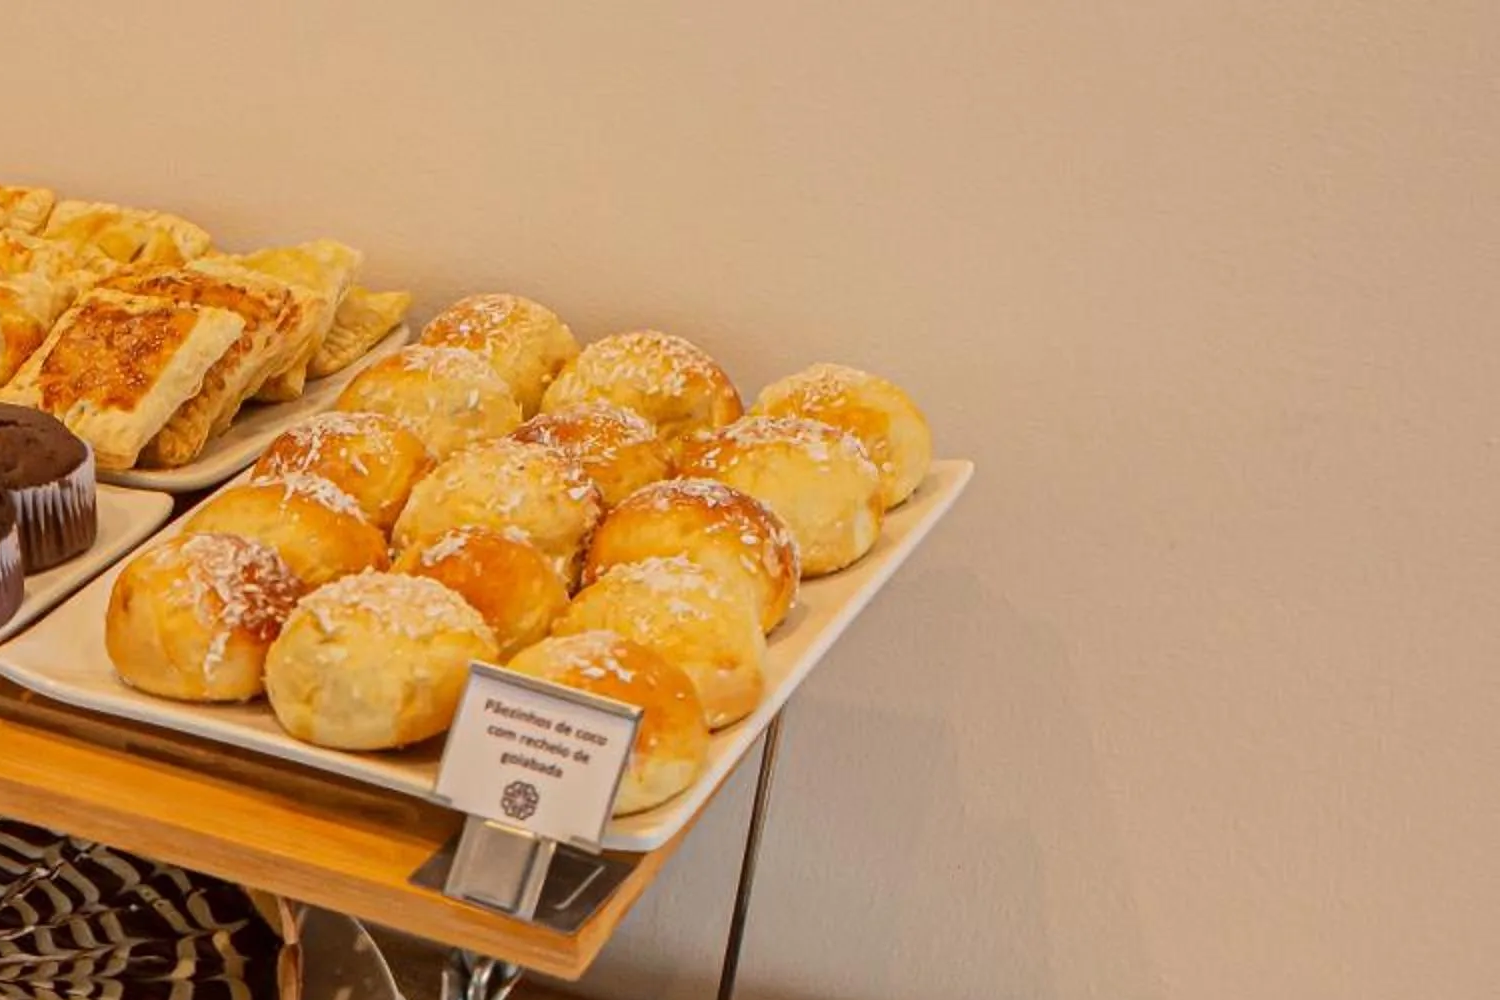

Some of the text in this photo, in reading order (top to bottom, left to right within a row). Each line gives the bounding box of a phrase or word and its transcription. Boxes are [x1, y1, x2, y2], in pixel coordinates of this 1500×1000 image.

[484, 698, 609, 747] Pãezinhos de coco
[487, 723, 591, 765] com recheio de
[500, 750, 564, 779] goiabada
